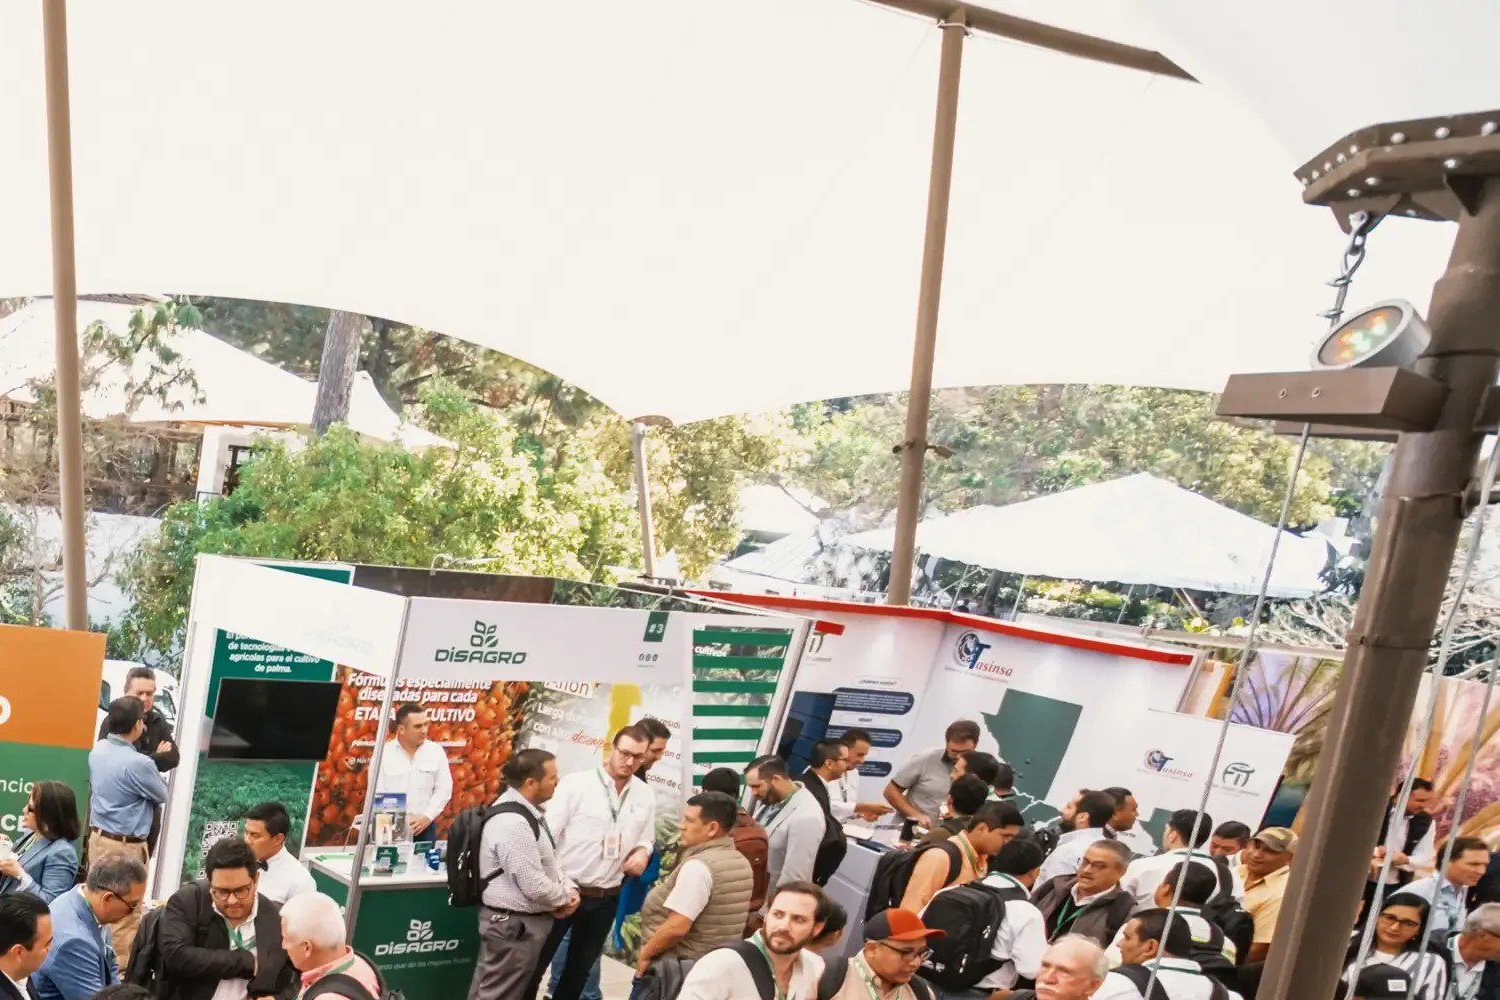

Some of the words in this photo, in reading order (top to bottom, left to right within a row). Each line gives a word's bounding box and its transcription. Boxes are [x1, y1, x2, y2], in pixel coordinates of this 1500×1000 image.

[648, 623, 664, 634] #3
[228, 641, 239, 650] de
[266, 654, 284, 664] para
[285, 655, 293, 663] el
[294, 655, 320, 664] cultivo
[254, 664, 265, 672] de
[266, 664, 292, 673] palma.
[407, 678, 492, 690] especialmente
[359, 688, 420, 702] diseadas
[422, 691, 449, 704] para
[450, 689, 478, 703] cada
[354, 706, 397, 721] ETAA
[424, 708, 476, 722] CULTIVO
[537, 702, 565, 720] Larga
[533, 722, 551, 735] con
